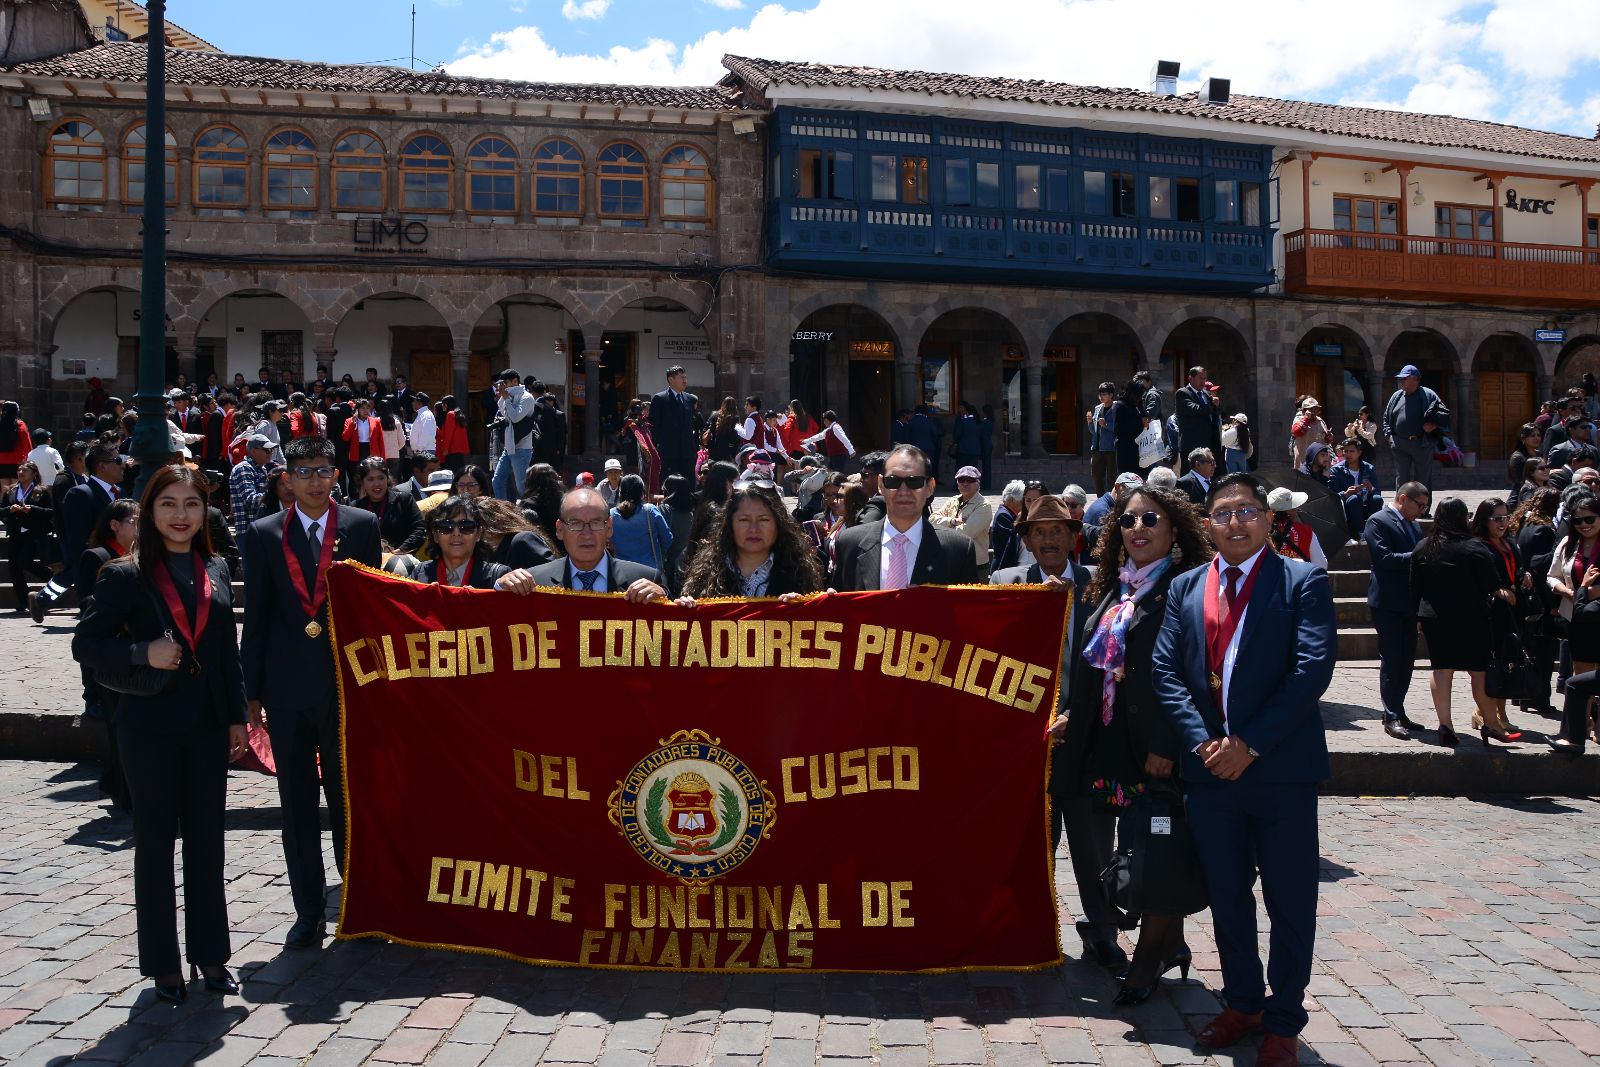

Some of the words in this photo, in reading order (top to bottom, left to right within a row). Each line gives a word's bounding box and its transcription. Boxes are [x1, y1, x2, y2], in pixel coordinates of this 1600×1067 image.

[1519, 198, 1555, 214] KFC
[354, 218, 429, 248] LIMO
[853, 342, 889, 354] HANZ
[343, 626, 494, 687] COLEGIO
[508, 620, 561, 671] DE
[579, 619, 843, 670] CONTADORES
[854, 623, 1053, 714] PUBLICOS
[512, 748, 591, 800] DEL
[781, 746, 920, 803] CUSCO
[626, 744, 700, 791] CONTADORES
[706, 747, 760, 800] PUBLICOS
[621, 799, 636, 817] DE
[748, 804, 763, 828] DEL
[625, 822, 671, 870] COLEGIO
[716, 836, 757, 871] CUSCO
[427, 856, 576, 923] COMITE
[605, 883, 840, 930] FUNCIONAL
[862, 881, 915, 927] DE
[579, 929, 814, 968] FINANZAS
